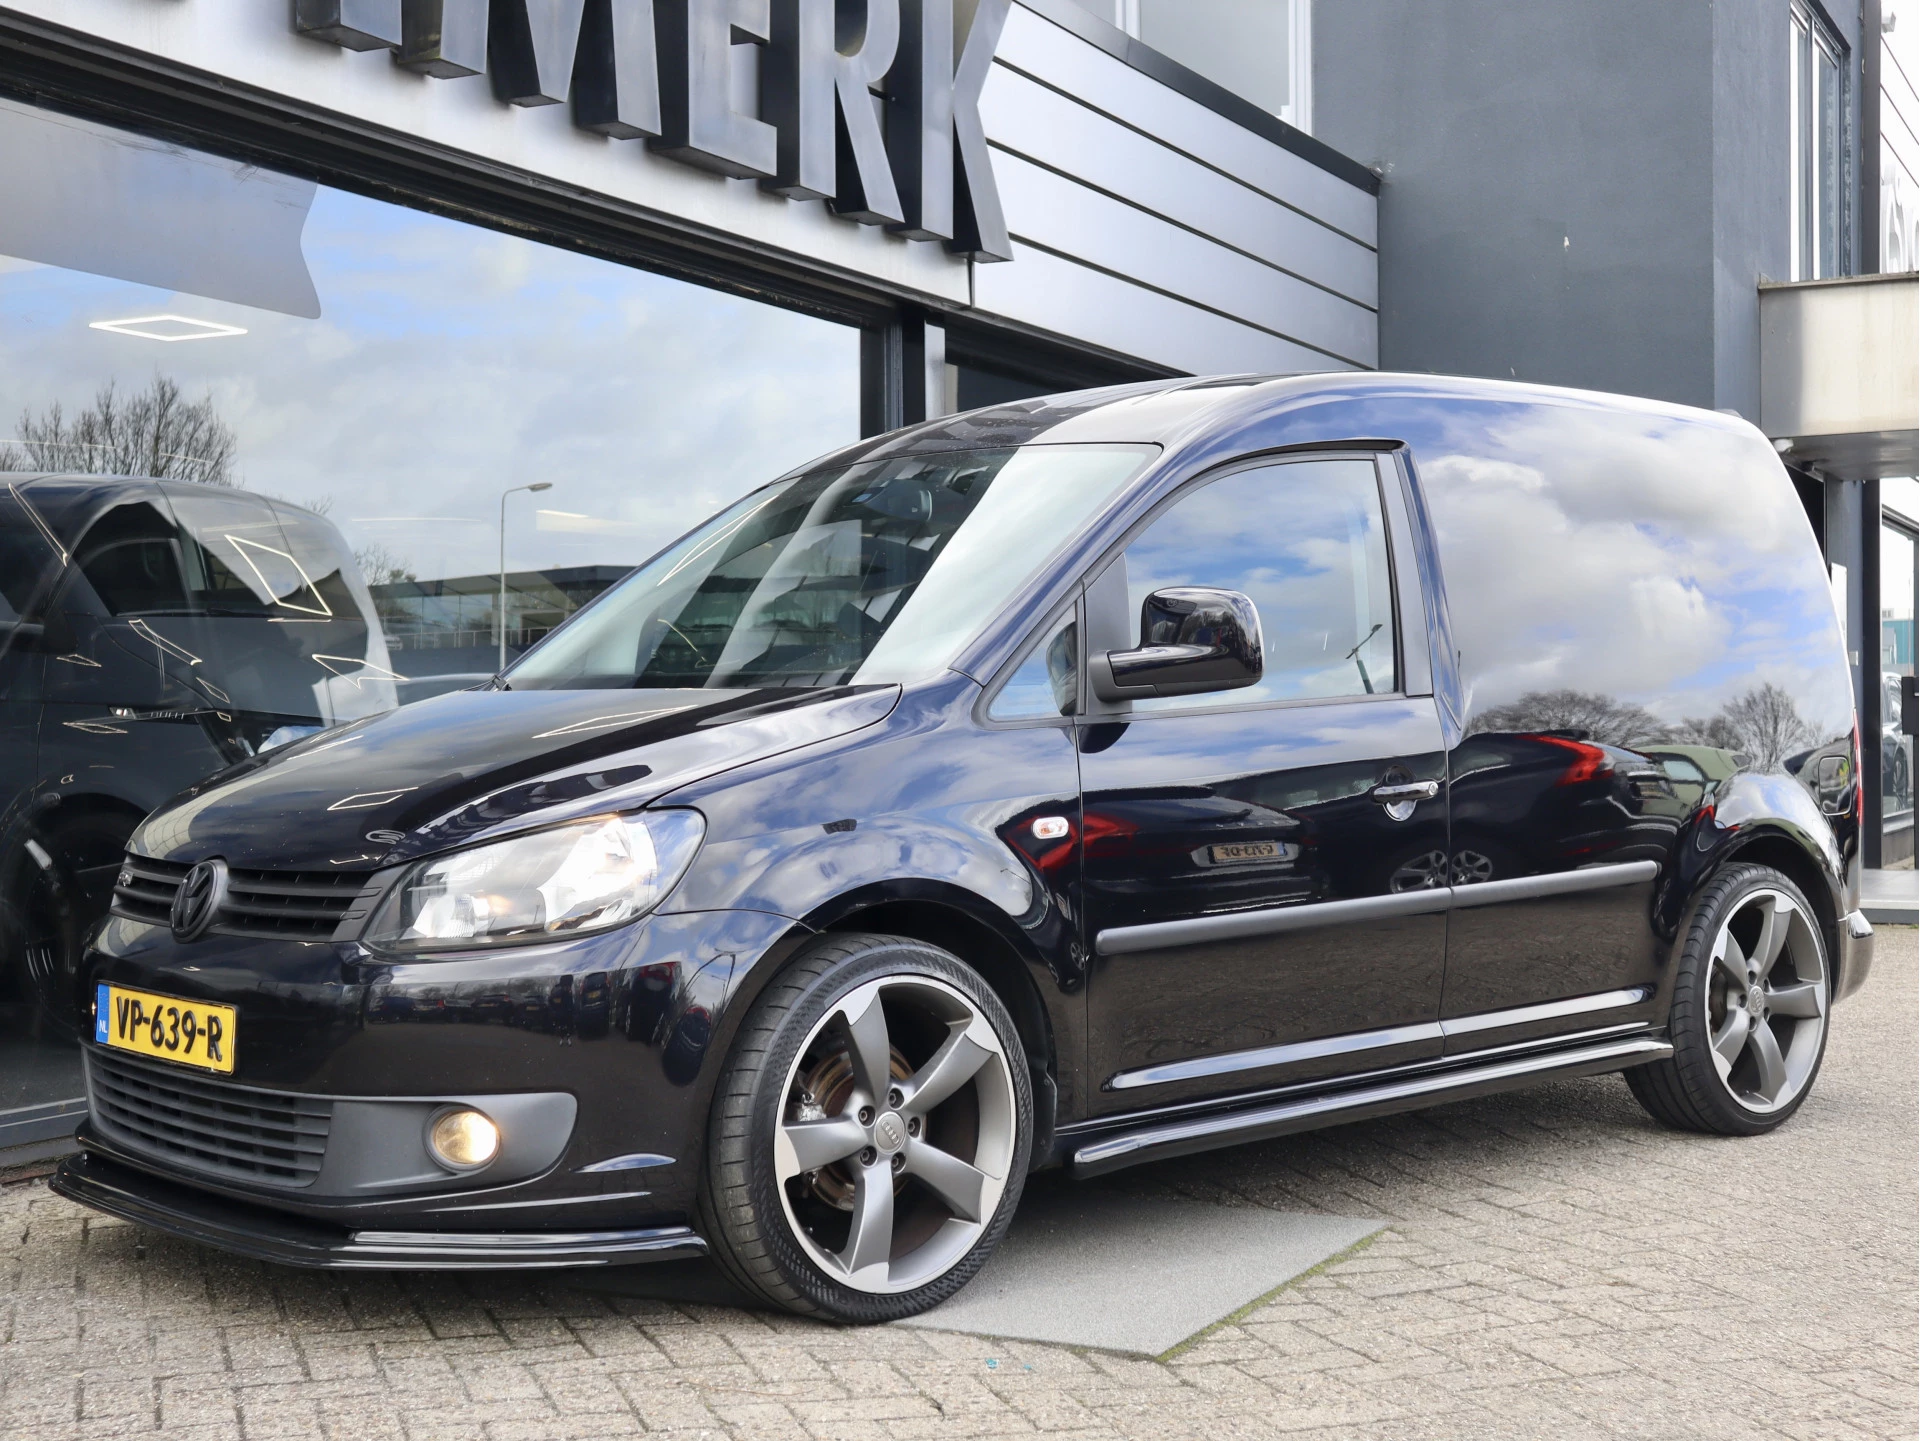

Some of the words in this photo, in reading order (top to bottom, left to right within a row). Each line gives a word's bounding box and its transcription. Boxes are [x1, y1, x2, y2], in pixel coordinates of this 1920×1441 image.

[297, 0, 1014, 262] ERK
[99, 1020, 108, 1033] NL
[116, 996, 223, 1062] VP-639-R
